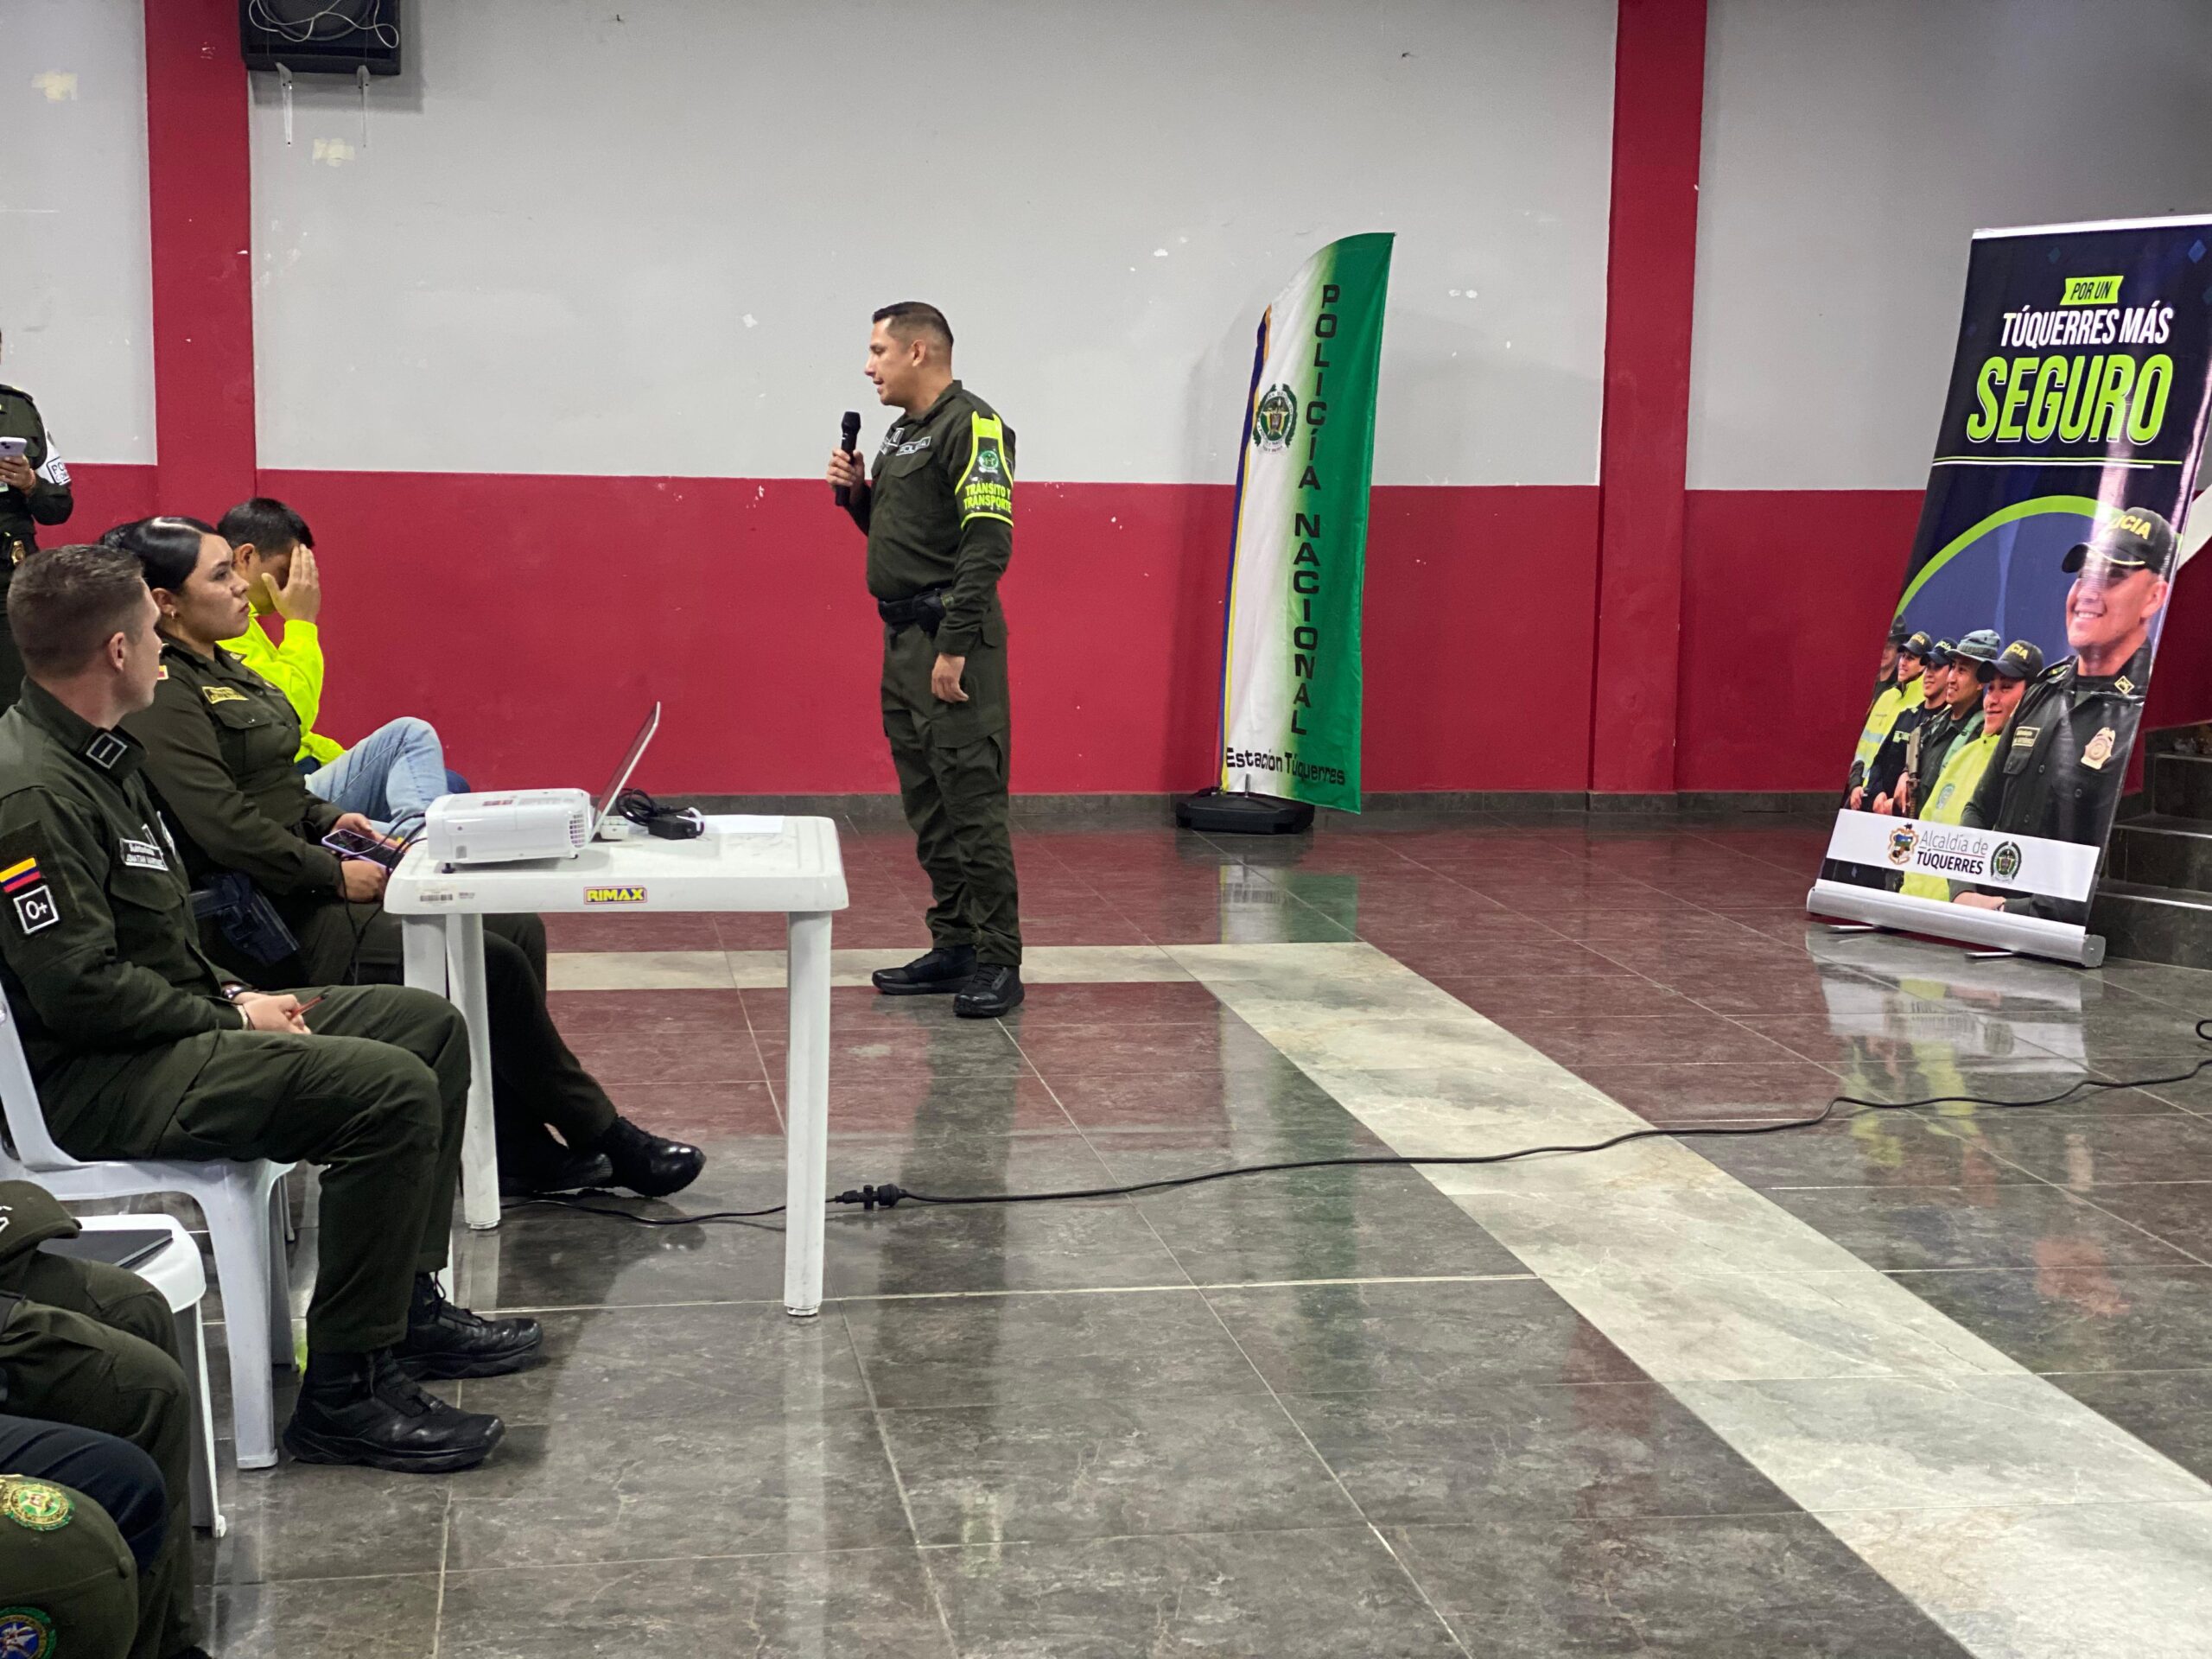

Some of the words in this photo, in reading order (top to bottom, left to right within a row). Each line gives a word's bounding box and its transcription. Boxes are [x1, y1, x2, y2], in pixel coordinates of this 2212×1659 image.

[2070, 283, 2092, 300] POR
[2094, 281, 2113, 299] UN
[2000, 305, 2120, 349] TÚQUERRES
[2119, 300, 2175, 344] MÁS
[1298, 284, 1340, 491] POLICÍA
[1967, 353, 2174, 445] SEGURO
[963, 494, 1012, 513] TRANSPORTE
[1291, 512, 1321, 735] NACIONAL
[1285, 752, 1346, 785] Túquerres
[1920, 830, 1968, 853] Alcaldía
[1972, 836, 1988, 855] de
[1916, 848, 1984, 875] TÚQUERRES
[587, 888, 644, 901] RIMAX
